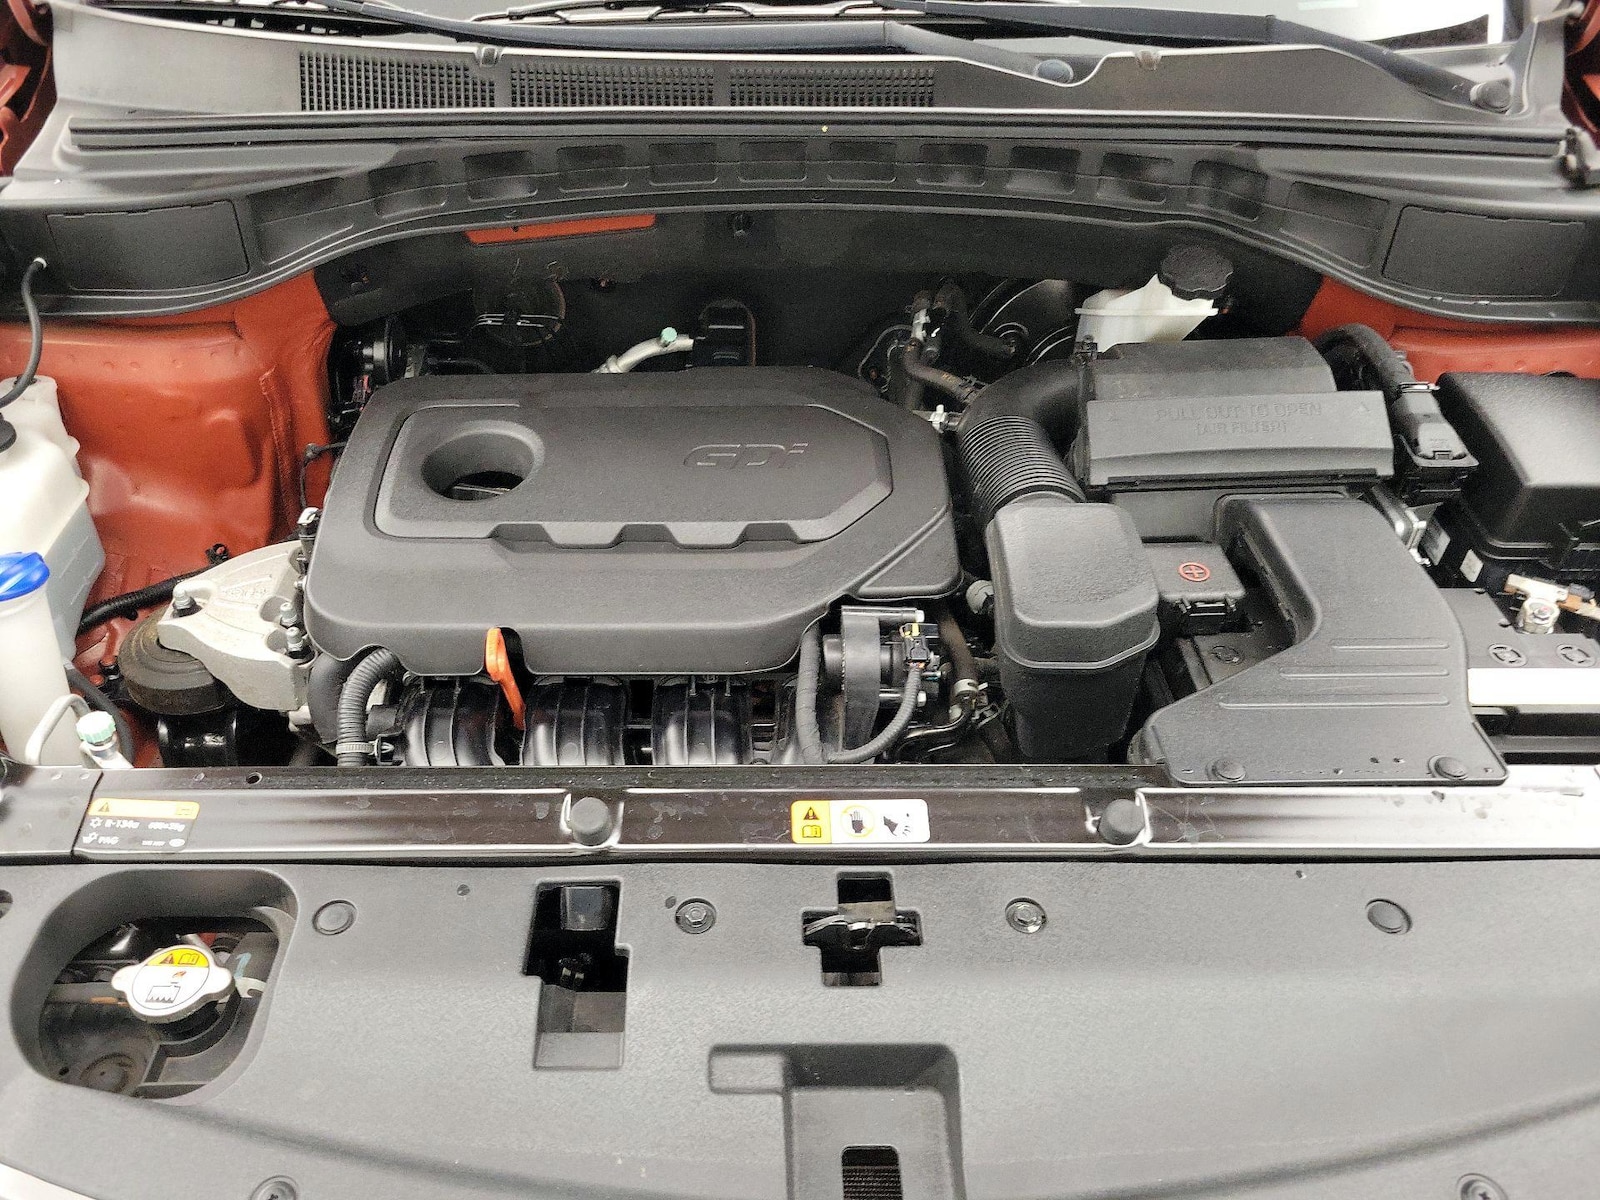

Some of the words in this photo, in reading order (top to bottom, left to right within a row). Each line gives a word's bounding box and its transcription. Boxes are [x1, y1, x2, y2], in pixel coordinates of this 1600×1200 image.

[1155, 407, 1200, 421] PULL
[1204, 405, 1241, 419] OUT
[1249, 403, 1269, 417] TO
[1272, 402, 1322, 416] OPEN
[98, 836, 119, 845] PAG
